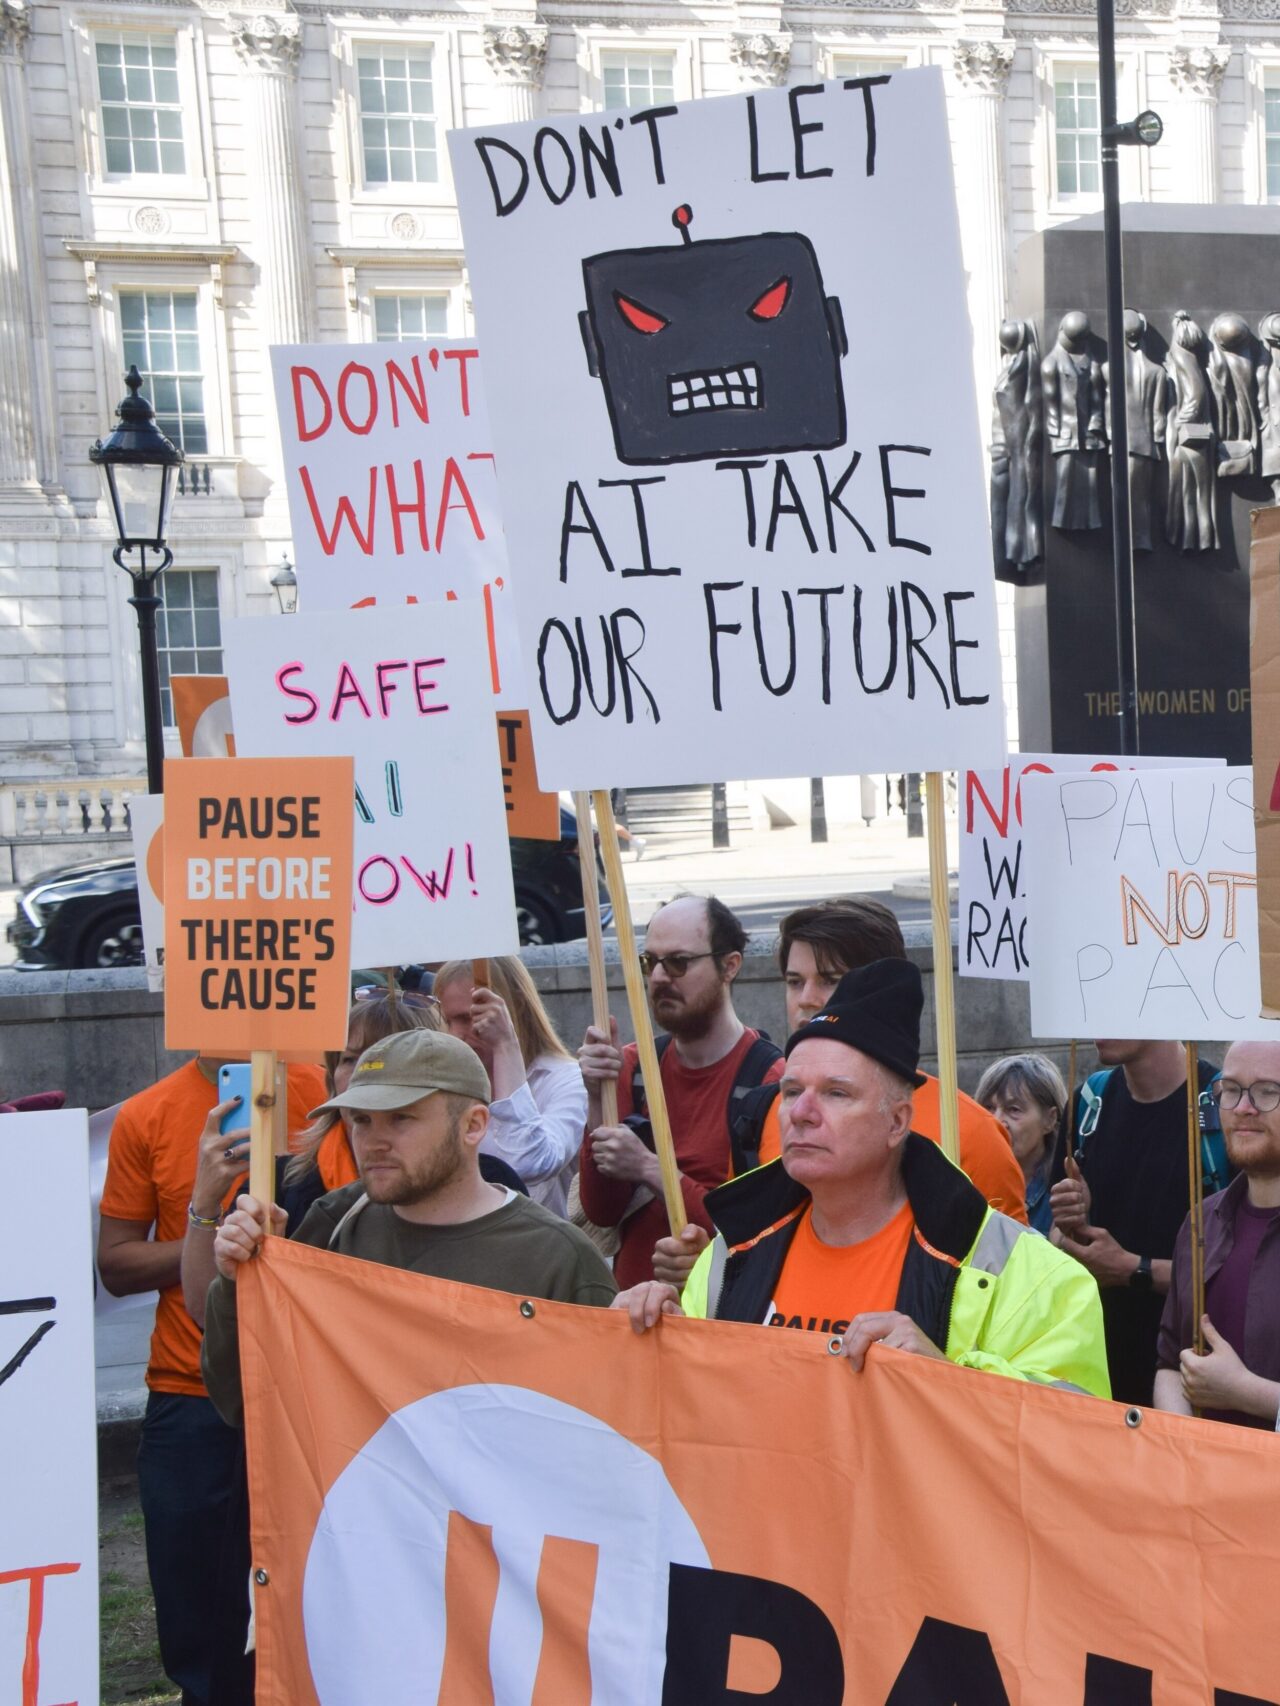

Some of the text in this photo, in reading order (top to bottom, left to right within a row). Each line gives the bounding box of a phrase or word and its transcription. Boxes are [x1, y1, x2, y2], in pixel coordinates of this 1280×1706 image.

[475, 74, 892, 217] DON'T LET
[290, 347, 480, 442] DON'T
[559, 445, 932, 584] AI TAKE
[536, 607, 661, 726] OUR
[703, 580, 990, 712] FUTURE
[274, 657, 451, 727] SAFE
[1138, 688, 1216, 715] WOMEN
[1227, 688, 1251, 713] OF
[198, 796, 321, 839] PAUSE
[187, 856, 332, 900] BEFORE
[353, 840, 479, 912] OW!
[1120, 868, 1258, 947] NOT
[180, 918, 335, 962] THERE'S
[200, 967, 317, 1011] CAUSE
